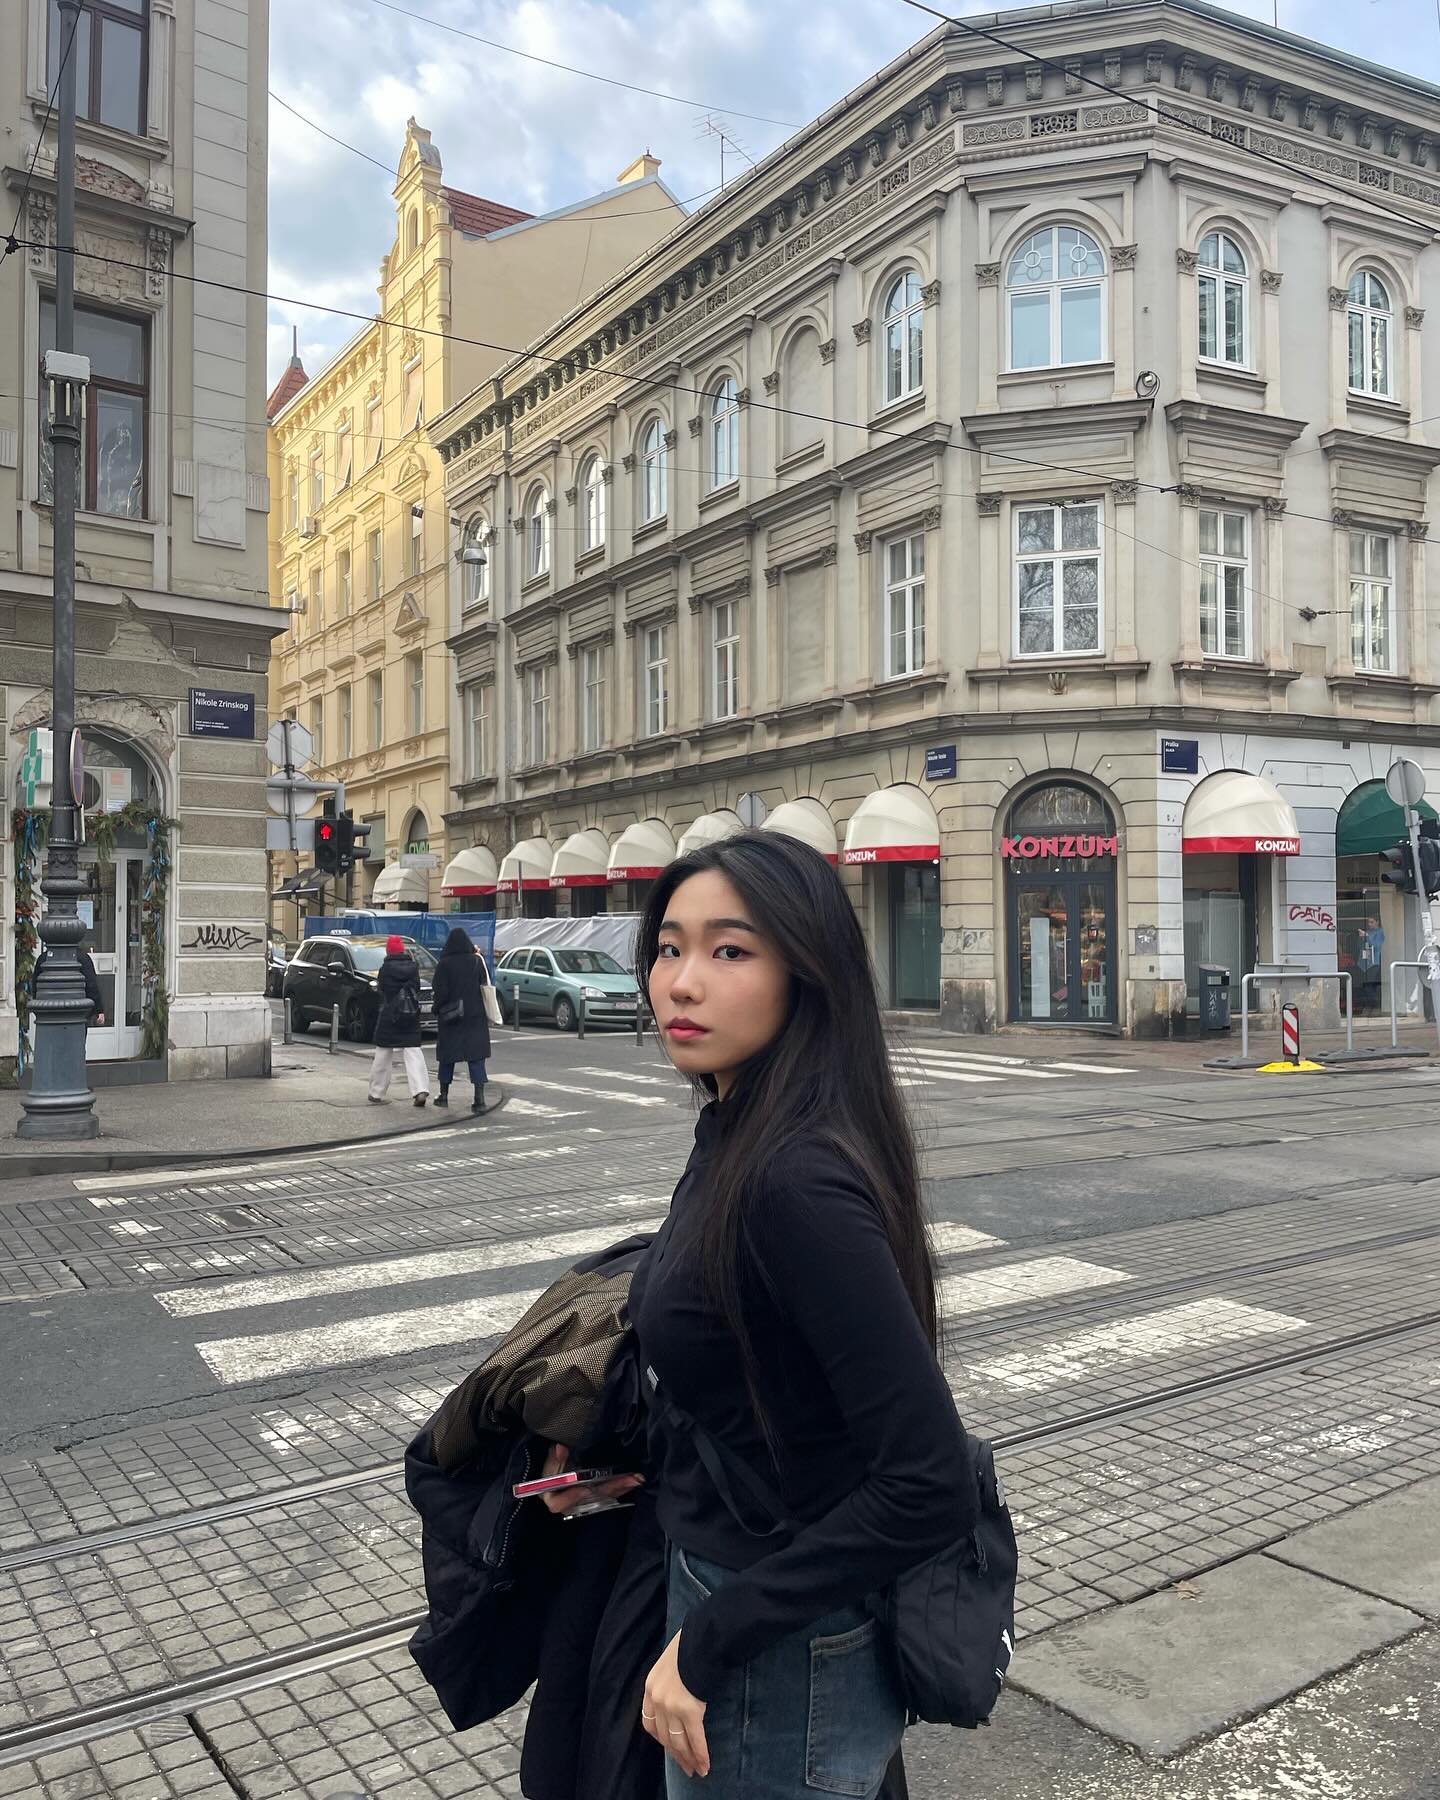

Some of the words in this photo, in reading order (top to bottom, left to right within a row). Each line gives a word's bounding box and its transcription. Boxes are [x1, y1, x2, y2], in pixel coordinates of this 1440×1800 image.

[195, 697, 218, 707] Nikole
[218, 700, 249, 712] Zrinskog
[1001, 835, 1118, 858] KONZUM
